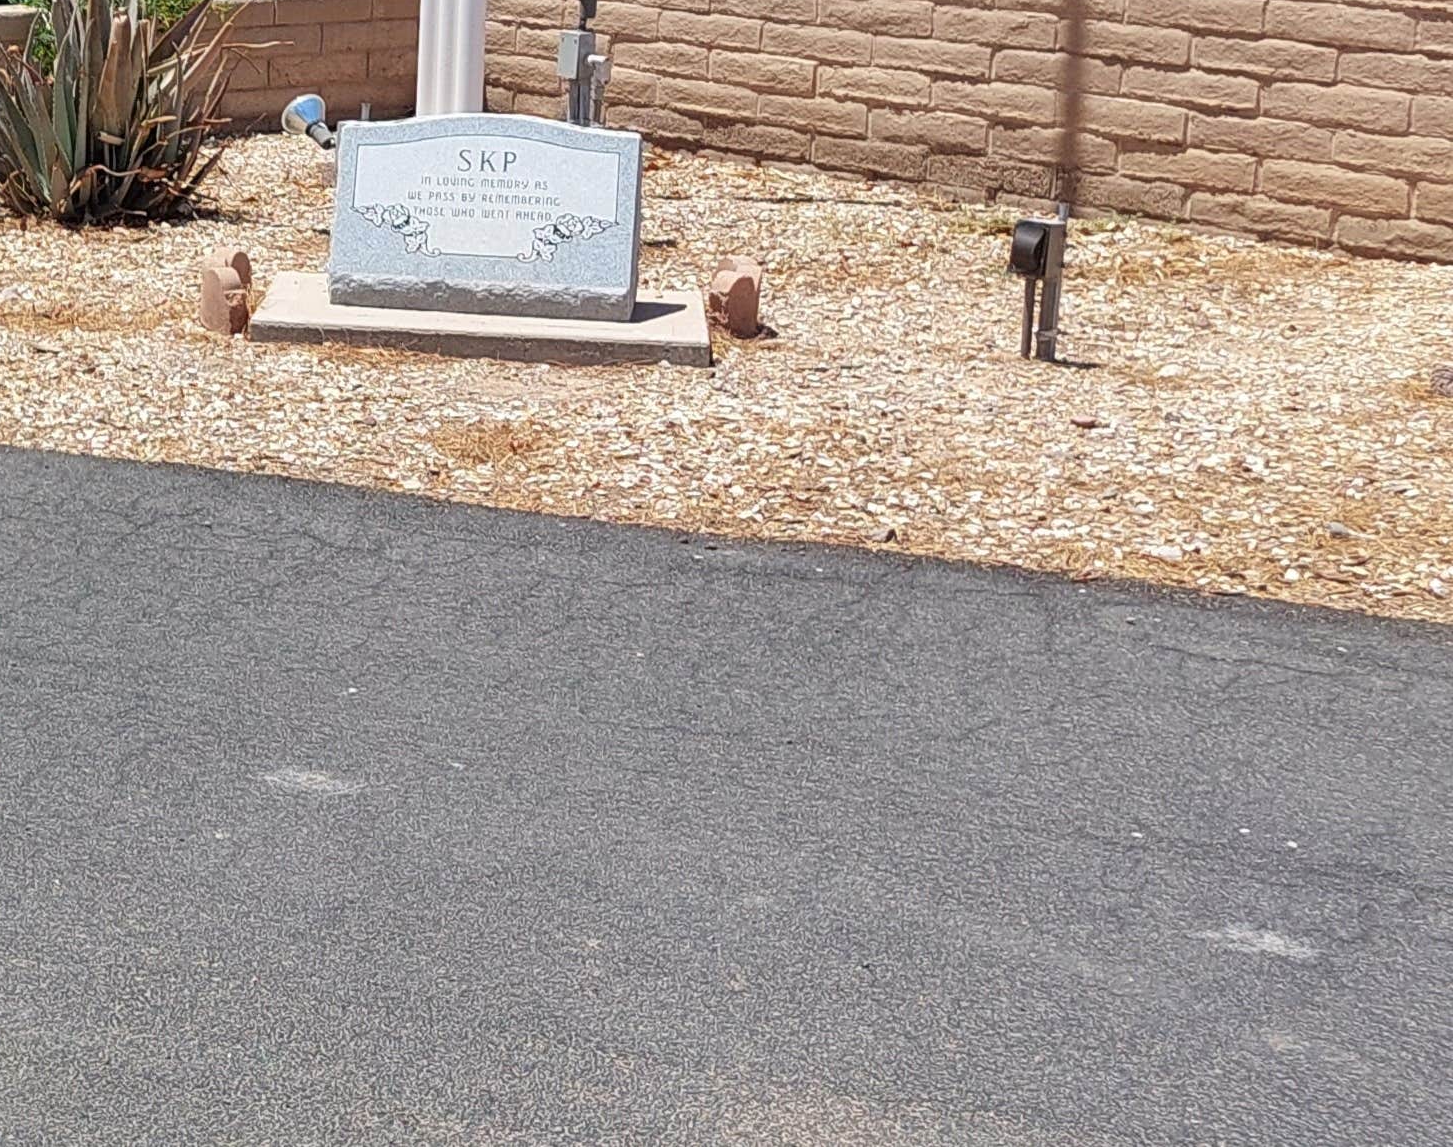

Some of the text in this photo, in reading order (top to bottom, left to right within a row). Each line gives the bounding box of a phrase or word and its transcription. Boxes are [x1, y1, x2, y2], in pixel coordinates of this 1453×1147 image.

[457, 149, 517, 173] SKP
[480, 178, 530, 191] MEMORY
[534, 180, 549, 191] AS
[407, 190, 561, 207] WE PASS BY REMEMBERING
[413, 206, 445, 217] THOSE
[451, 207, 475, 219] WHO
[481, 209, 510, 220] WENT
